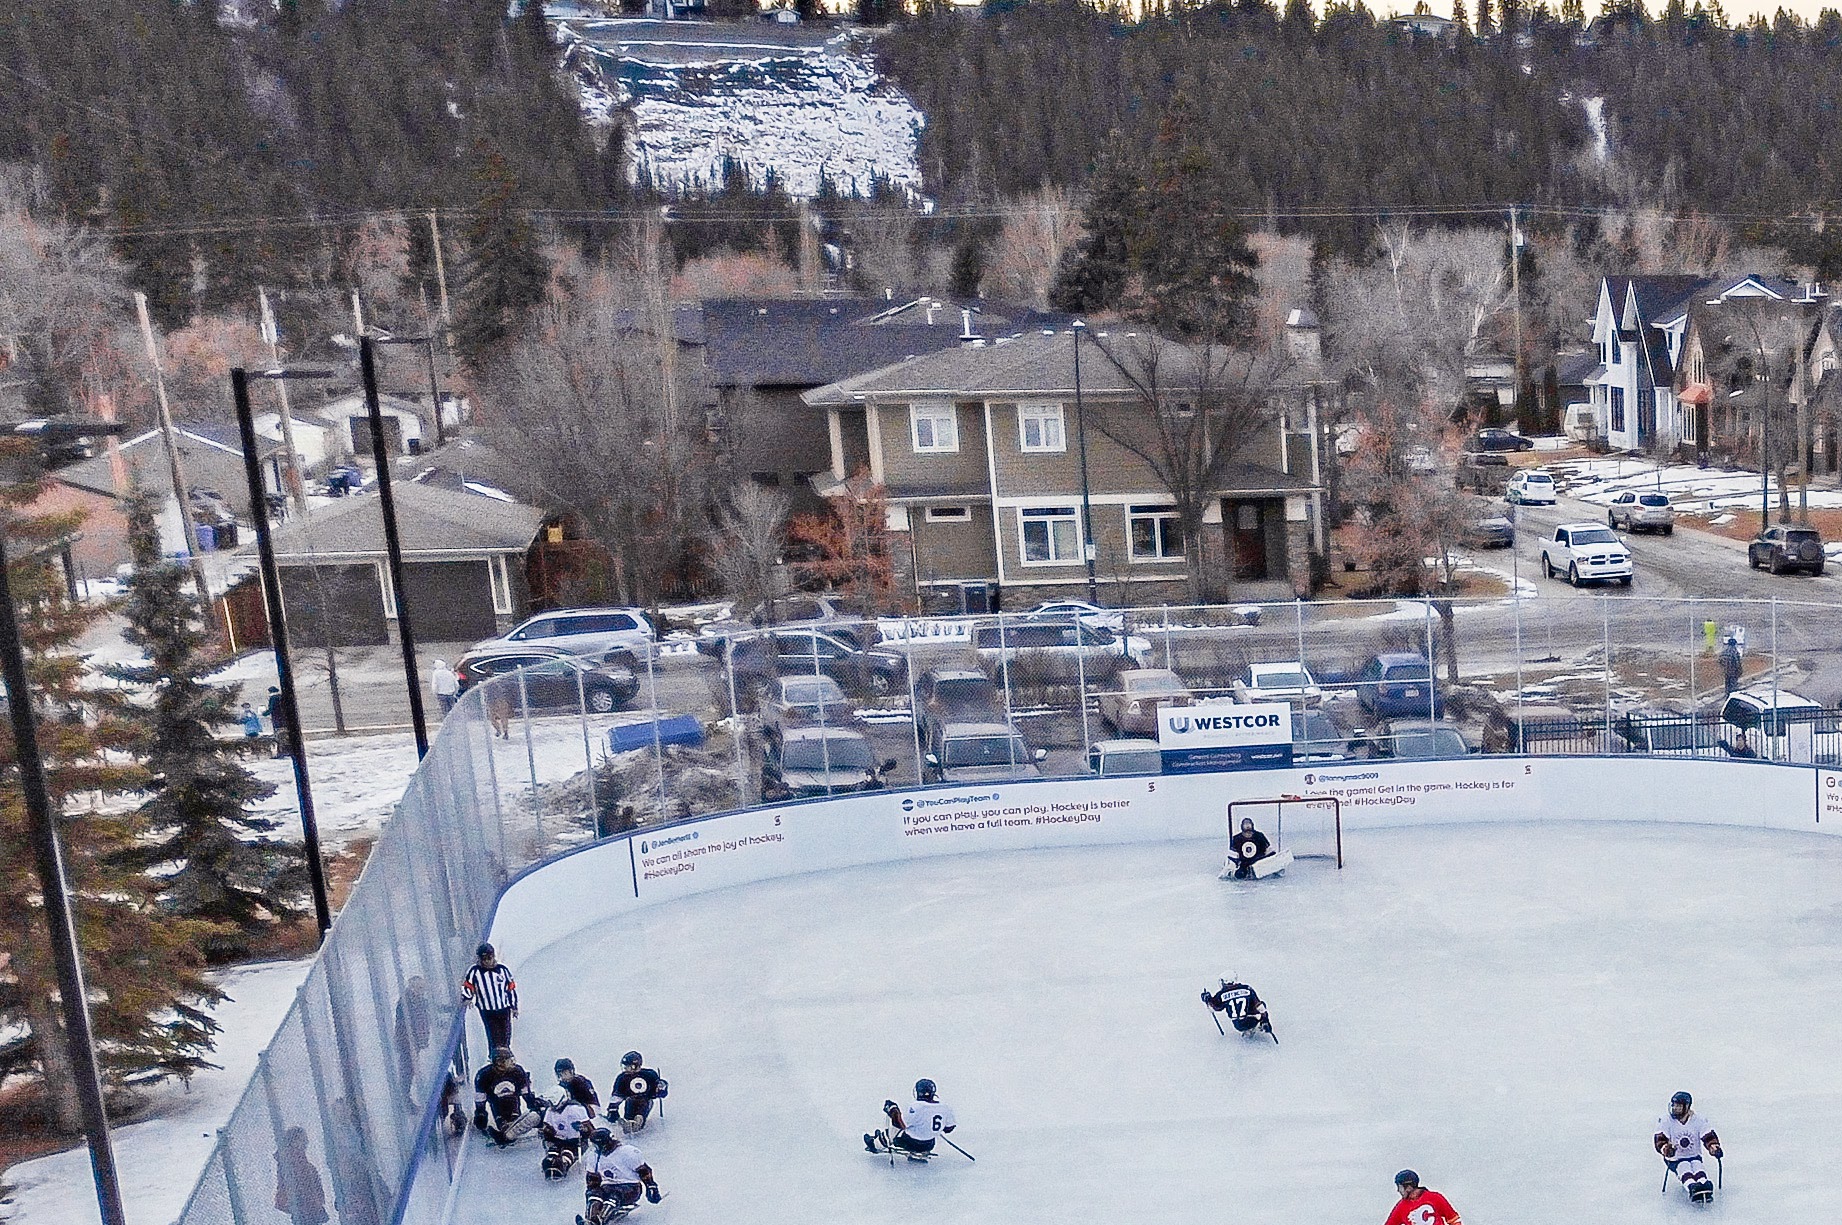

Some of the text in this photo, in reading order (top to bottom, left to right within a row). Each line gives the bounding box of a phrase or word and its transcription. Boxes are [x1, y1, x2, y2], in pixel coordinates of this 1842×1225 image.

[1195, 714, 1280, 730] WESTCOR
[1329, 787, 1344, 796] the
[1346, 786, 1376, 797] game!
[1377, 785, 1394, 793] Get
[1406, 783, 1422, 792] the
[1455, 781, 1491, 791] Hockey
[1492, 780, 1500, 788] is
[1501, 780, 1515, 788] for
[1826, 793, 1839, 802] We
[1355, 795, 1416, 806] #HockeyDay
[903, 816, 911, 825] If
[912, 814, 931, 826] you
[933, 812, 952, 821] can
[981, 808, 1001, 818] you
[1002, 806, 1022, 815] can
[1050, 802, 1089, 812] Hockey
[1090, 801, 1099, 810] is
[1100, 800, 1131, 809] better
[904, 826, 933, 837] when
[933, 825, 949, 833] we
[950, 822, 976, 832] have
[977, 821, 985, 829] a
[986, 818, 1003, 828] full
[1035, 813, 1101, 825] #HockeyDay
[642, 832, 785, 868] We can all share the joy of hockey.
[643, 862, 695, 880] #HockeyDay
[1229, 997, 1247, 1017] 17
[932, 1114, 943, 1132] 6
